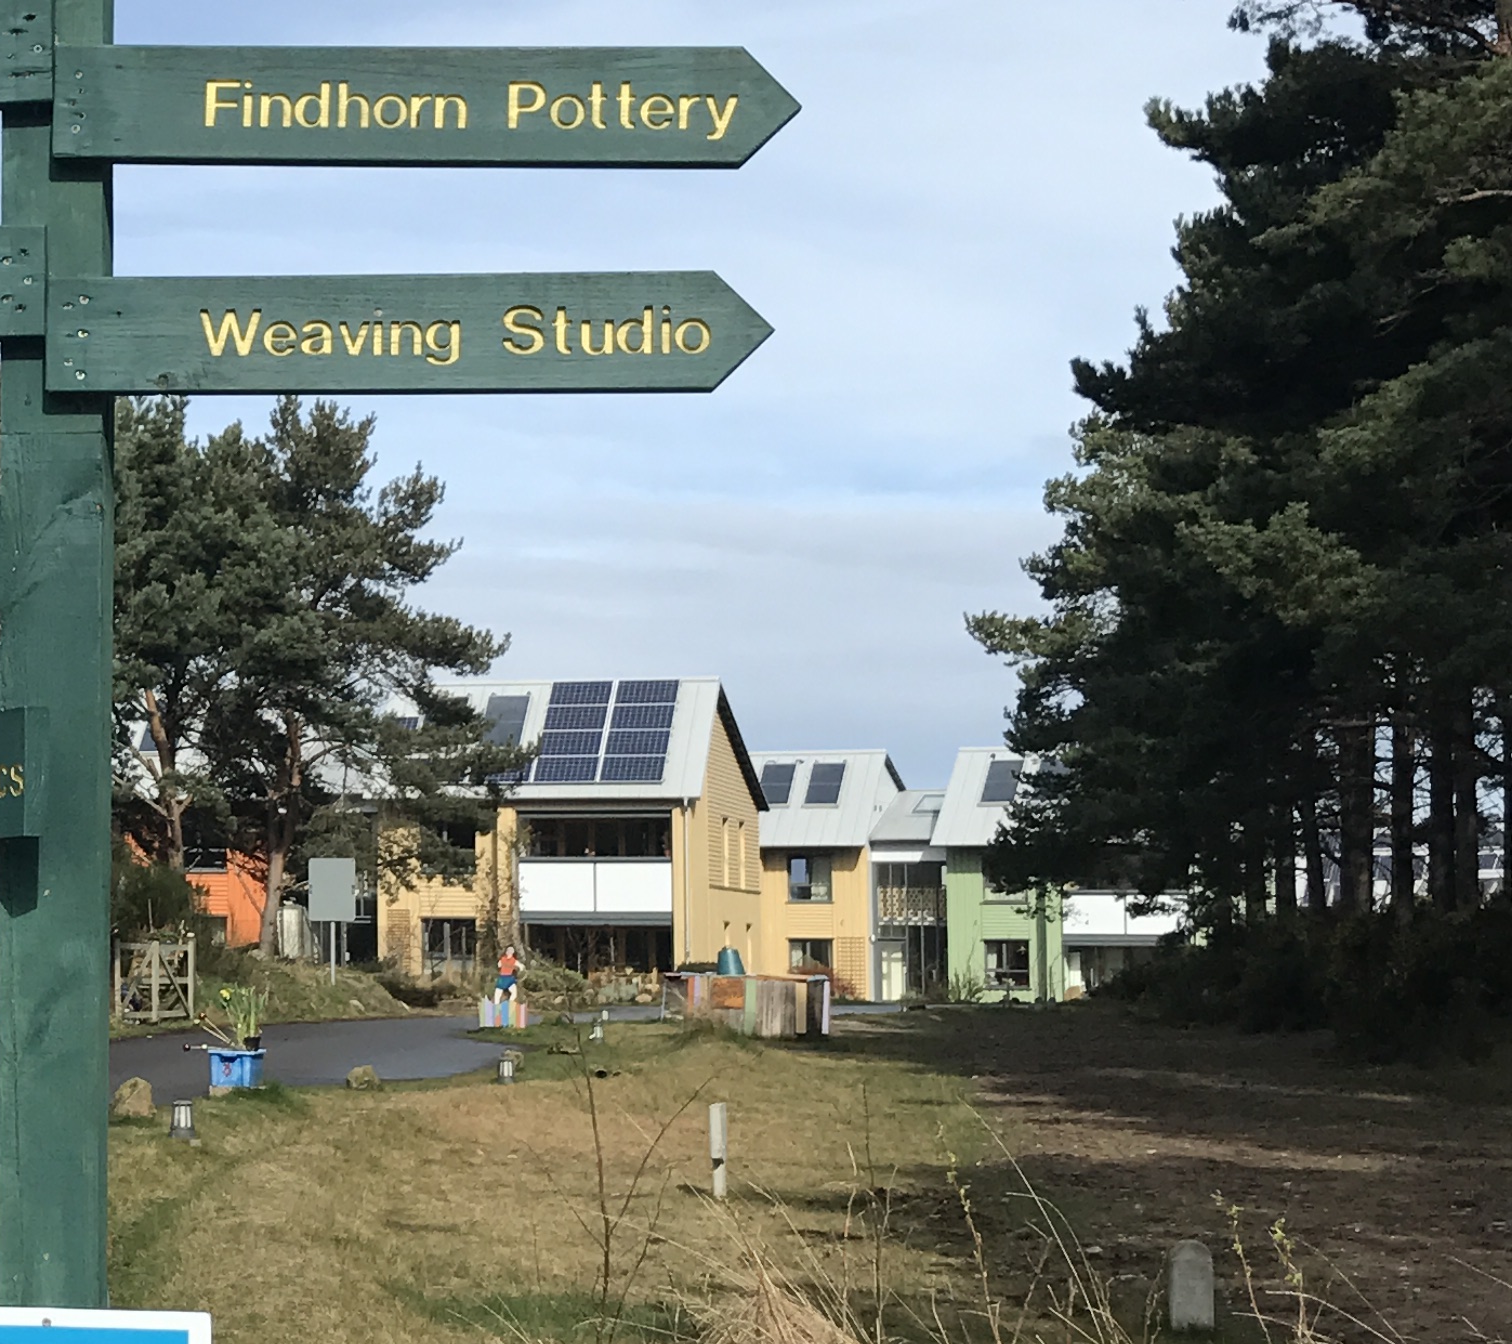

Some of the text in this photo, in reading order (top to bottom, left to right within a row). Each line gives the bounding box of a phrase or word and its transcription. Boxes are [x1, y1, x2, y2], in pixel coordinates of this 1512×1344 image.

[204, 79, 740, 141] Findhorn Pottery
[199, 305, 712, 366] Weaving Studio
